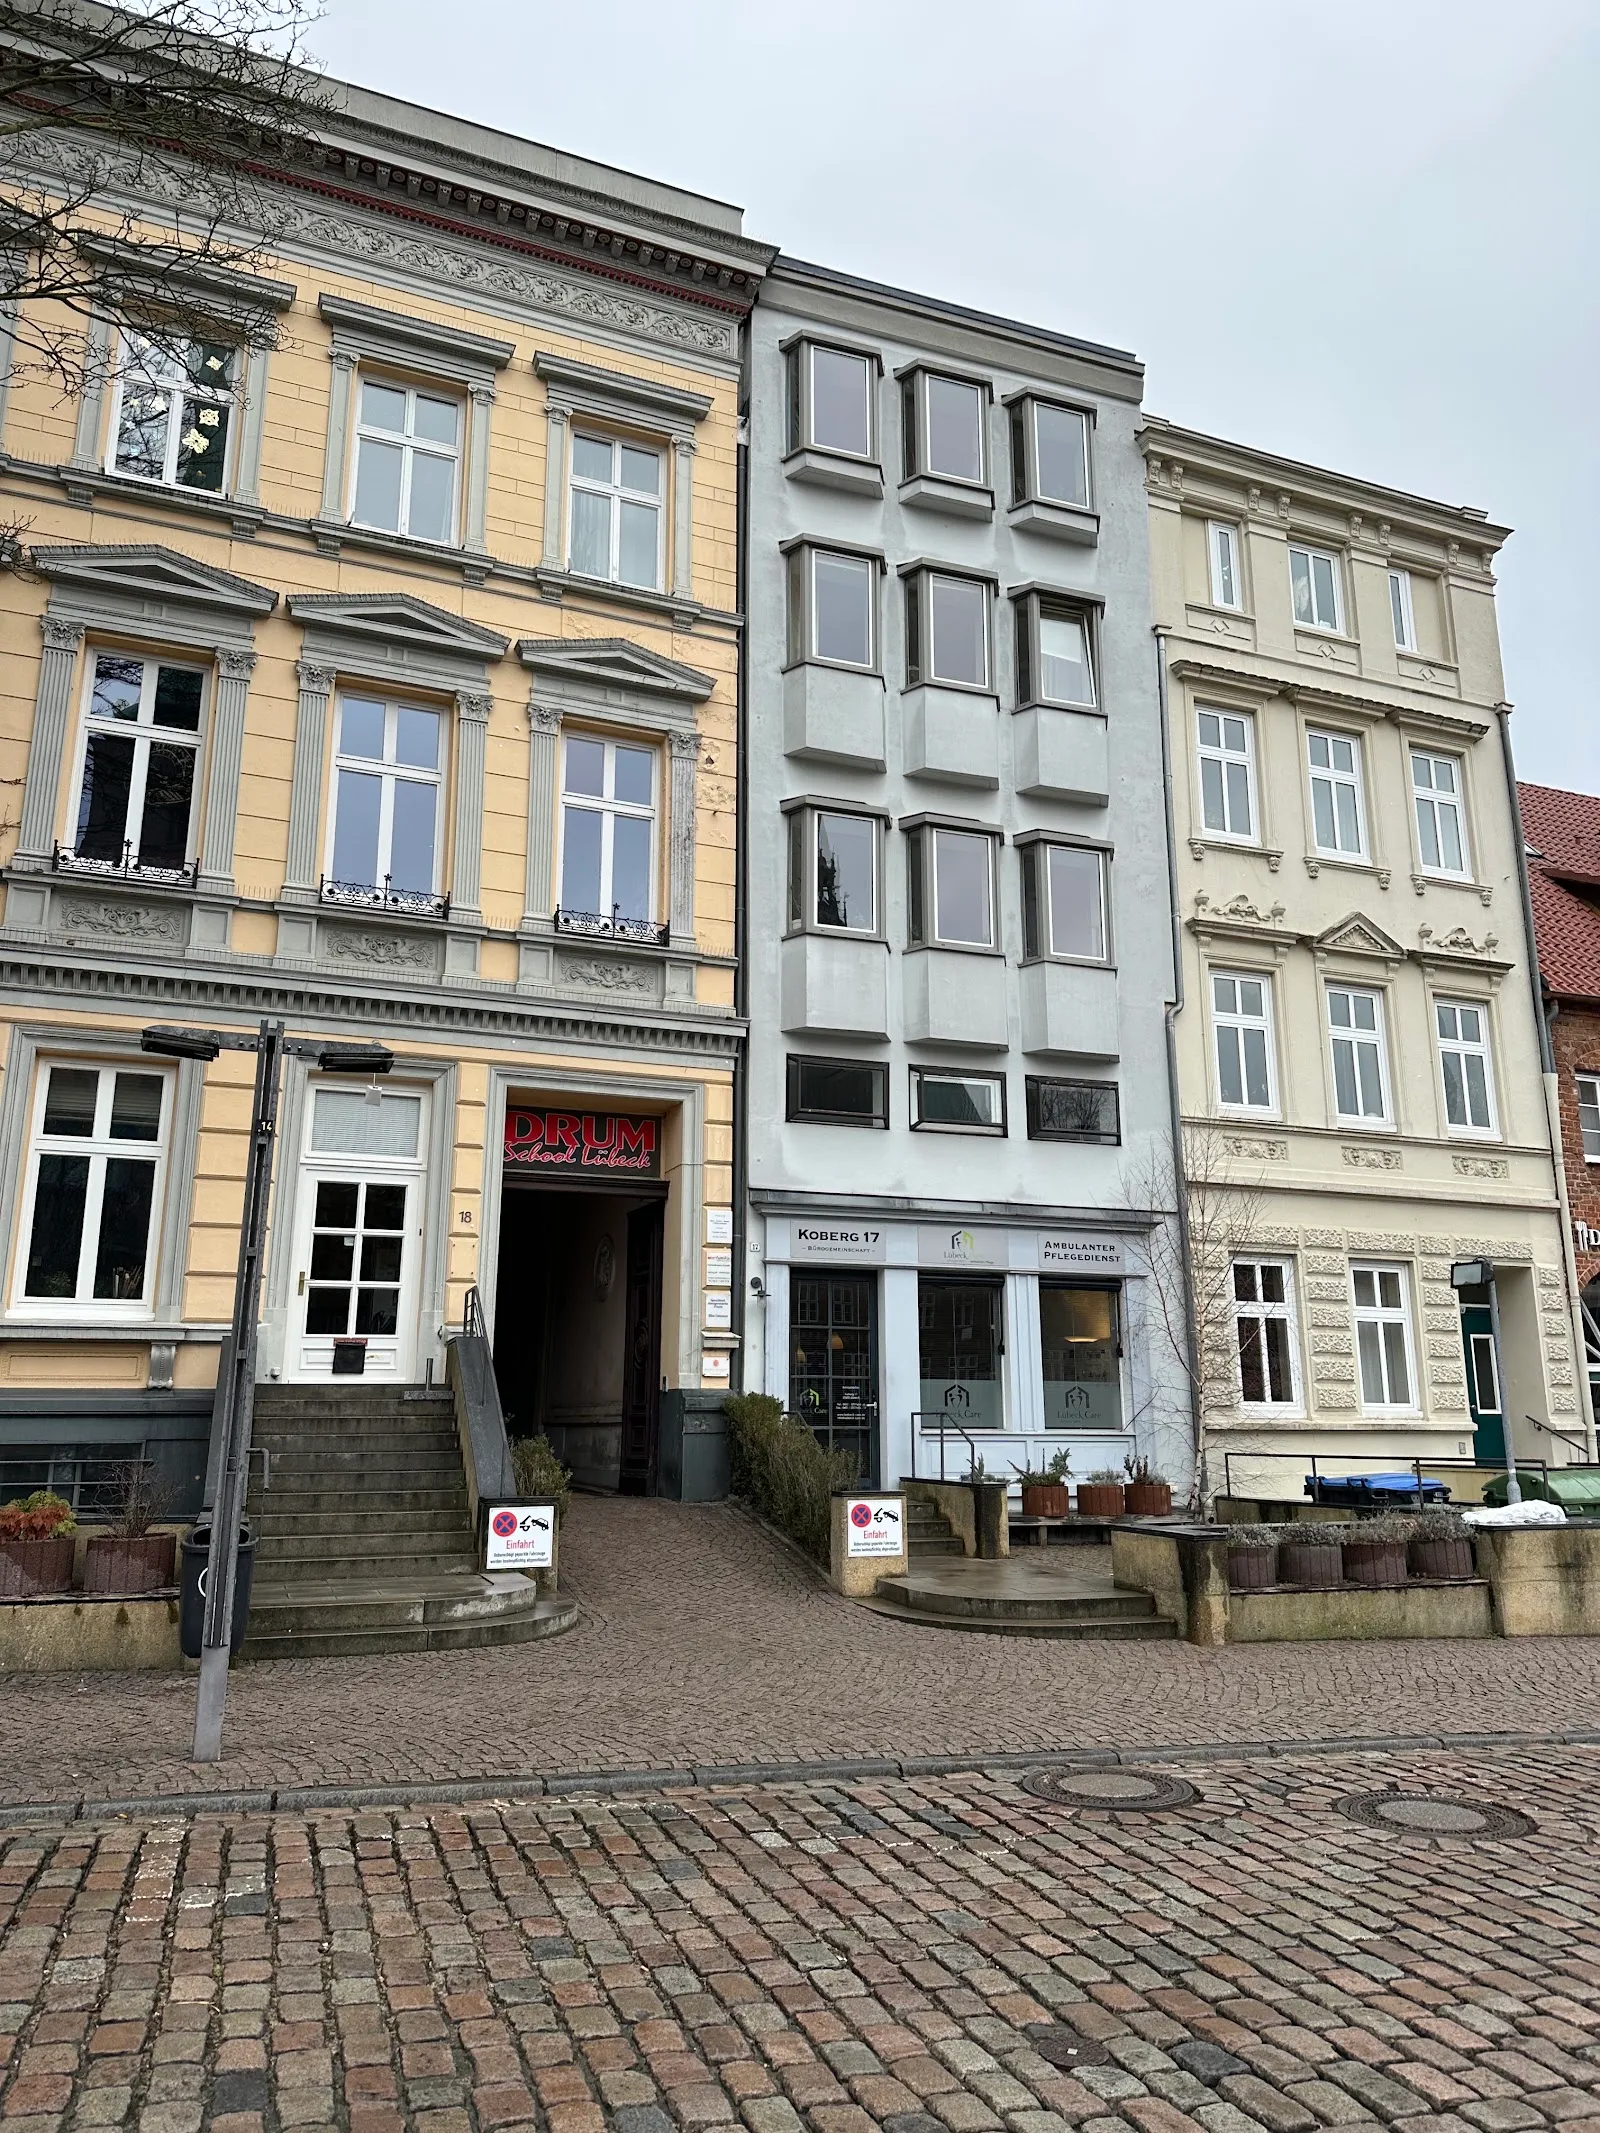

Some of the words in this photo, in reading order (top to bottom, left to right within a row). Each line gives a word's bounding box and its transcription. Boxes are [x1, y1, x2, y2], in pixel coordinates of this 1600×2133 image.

[504, 1111, 656, 1152] DRUM
[503, 1142, 577, 1164] School
[581, 1144, 651, 1168] Lübeck
[458, 1211, 472, 1223] 18
[798, 1228, 859, 1242] KOBERG
[863, 1232, 880, 1243] 17
[1044, 1241, 1116, 1252] AMBULANTER
[1044, 1251, 1121, 1262] PFLEGEDIENST
[964, 1409, 982, 1419] Care
[1084, 1410, 1101, 1419] Care
[864, 1530, 887, 1539] Einfahrt
[506, 1540, 535, 1549] Einfahrt
